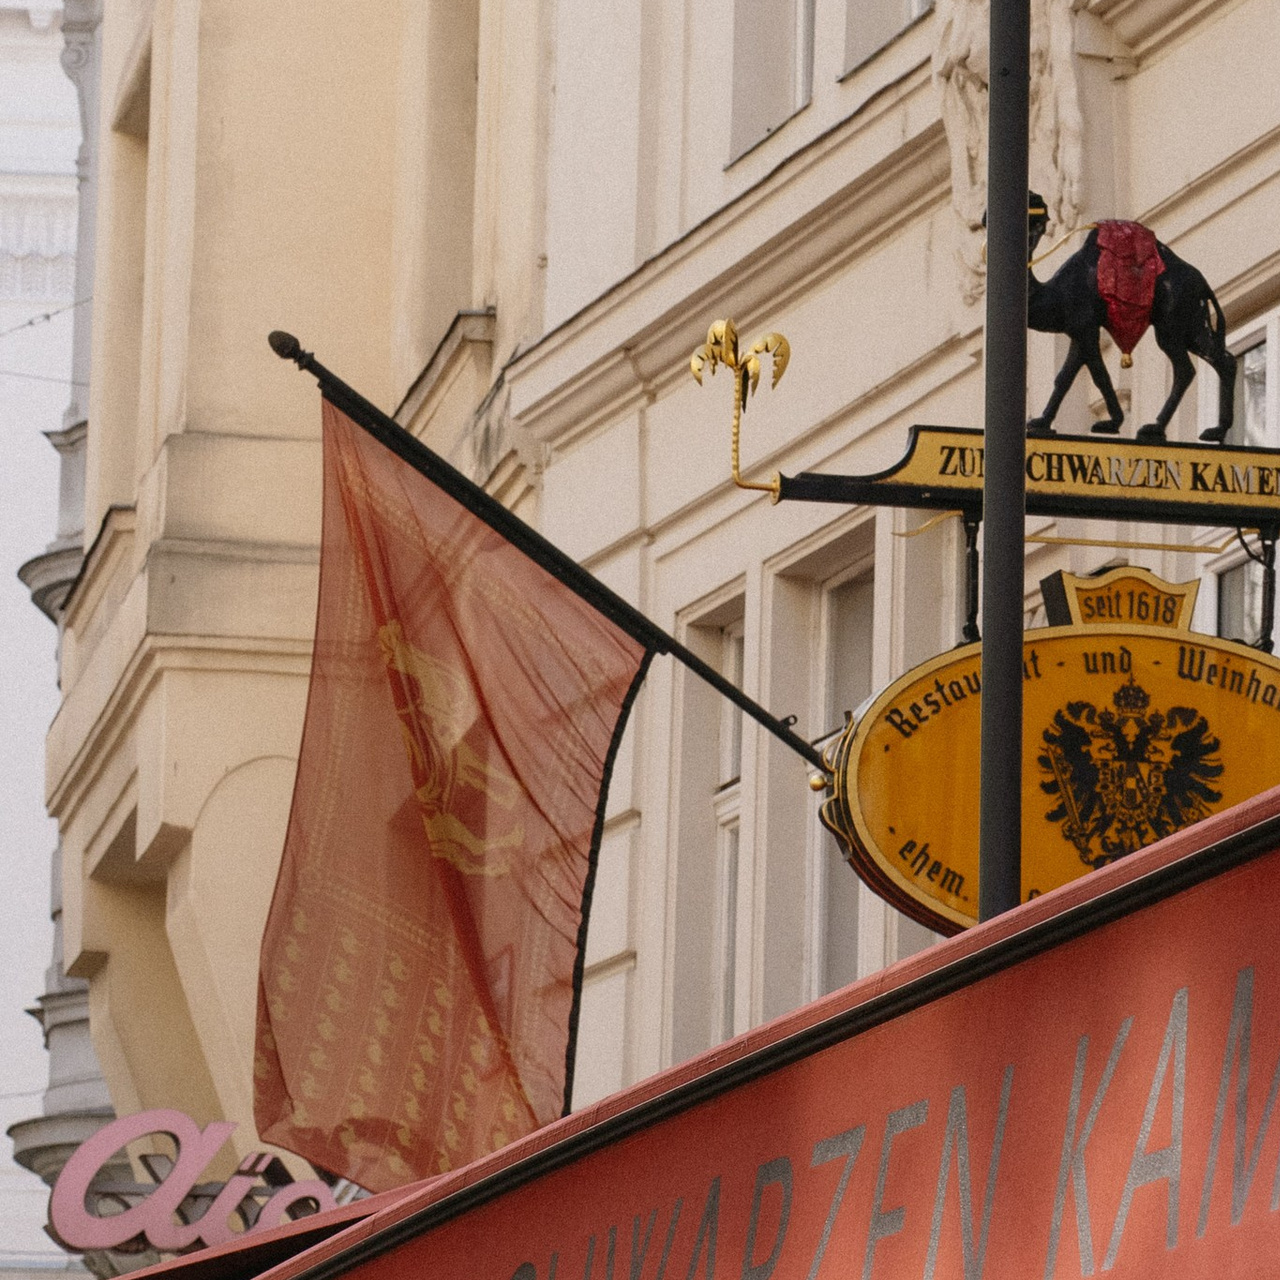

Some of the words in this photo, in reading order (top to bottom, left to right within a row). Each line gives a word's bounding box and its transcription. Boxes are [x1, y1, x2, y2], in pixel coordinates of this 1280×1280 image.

[939, 445, 985, 477] ZU
[1025, 451, 1185, 489] CHWARZEN
[1082, 585, 1125, 620] seit
[1127, 590, 1178, 625] 1618
[884, 649, 1042, 738] Restaut
[1082, 646, 1133, 674] und
[898, 838, 969, 903] ehem.
